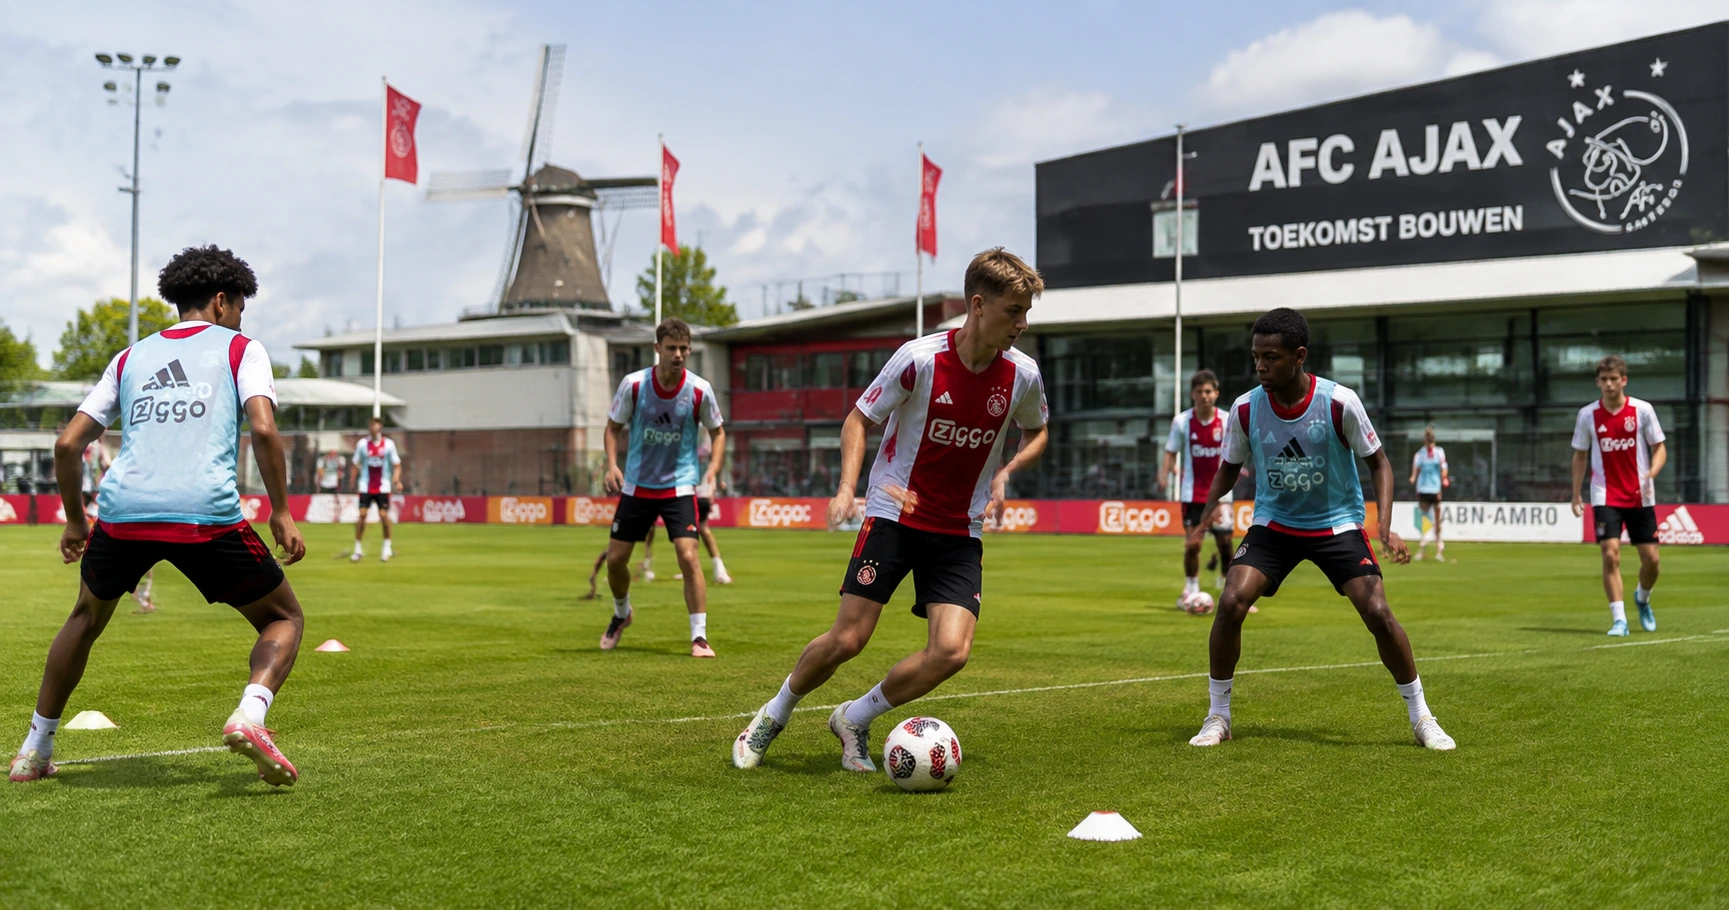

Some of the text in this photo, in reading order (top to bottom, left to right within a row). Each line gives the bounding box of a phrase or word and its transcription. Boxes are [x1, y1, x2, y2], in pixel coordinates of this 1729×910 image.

[1248, 115, 1524, 191] AFC AJAX
[1546, 85, 1615, 160] AJAX
[1248, 205, 1524, 251] TOEKOMST BOUWEN
